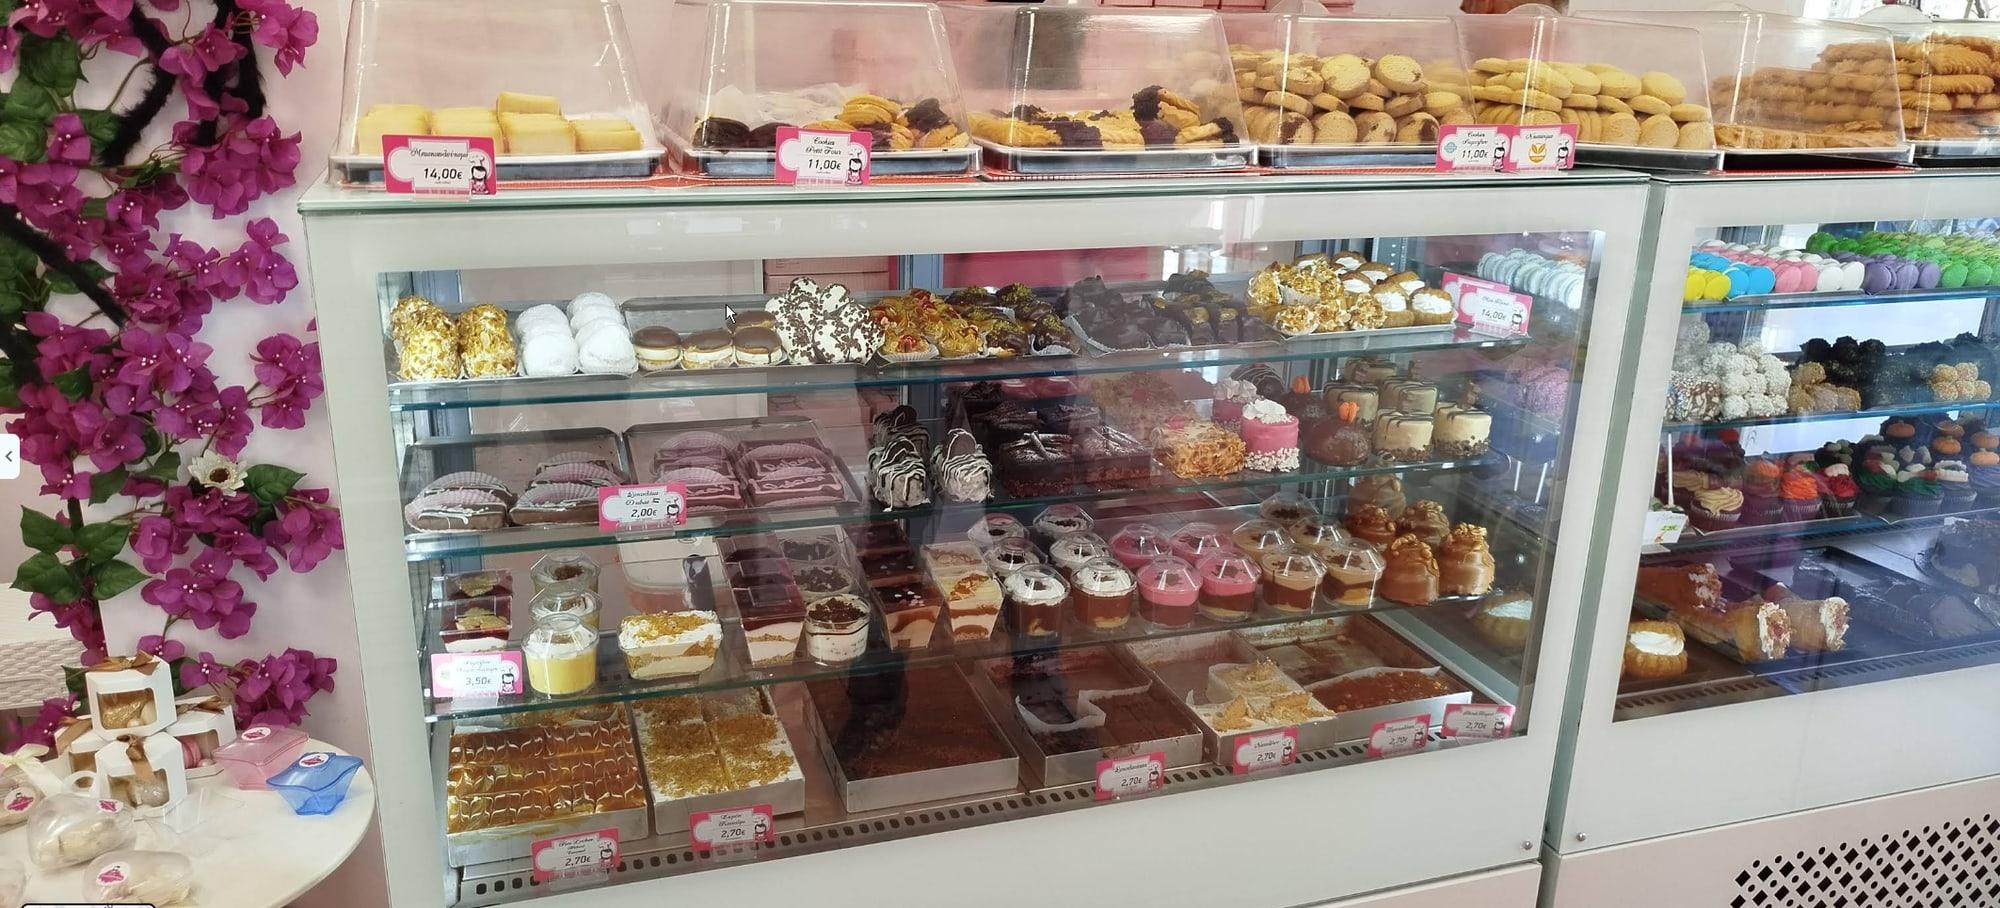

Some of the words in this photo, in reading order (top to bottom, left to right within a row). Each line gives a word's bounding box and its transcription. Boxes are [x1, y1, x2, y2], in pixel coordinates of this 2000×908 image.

[813, 136, 835, 146] Cookies
[824, 145, 842, 155] Four
[1462, 149, 1488, 159] 11,00€
[808, 158, 842, 171] 11,00€
[424, 168, 463, 180] 14,00€
[1481, 308, 1507, 321] 14,00€
[630, 508, 658, 518] 2,00€
[465, 676, 492, 686] 3,50€
[1465, 721, 1487, 730] 2,70€
[1257, 751, 1277, 762] 2,70€
[1121, 776, 1143, 787] 2,70€
[720, 828, 746, 838] 2,70€
[564, 855, 591, 867] 2,70€
